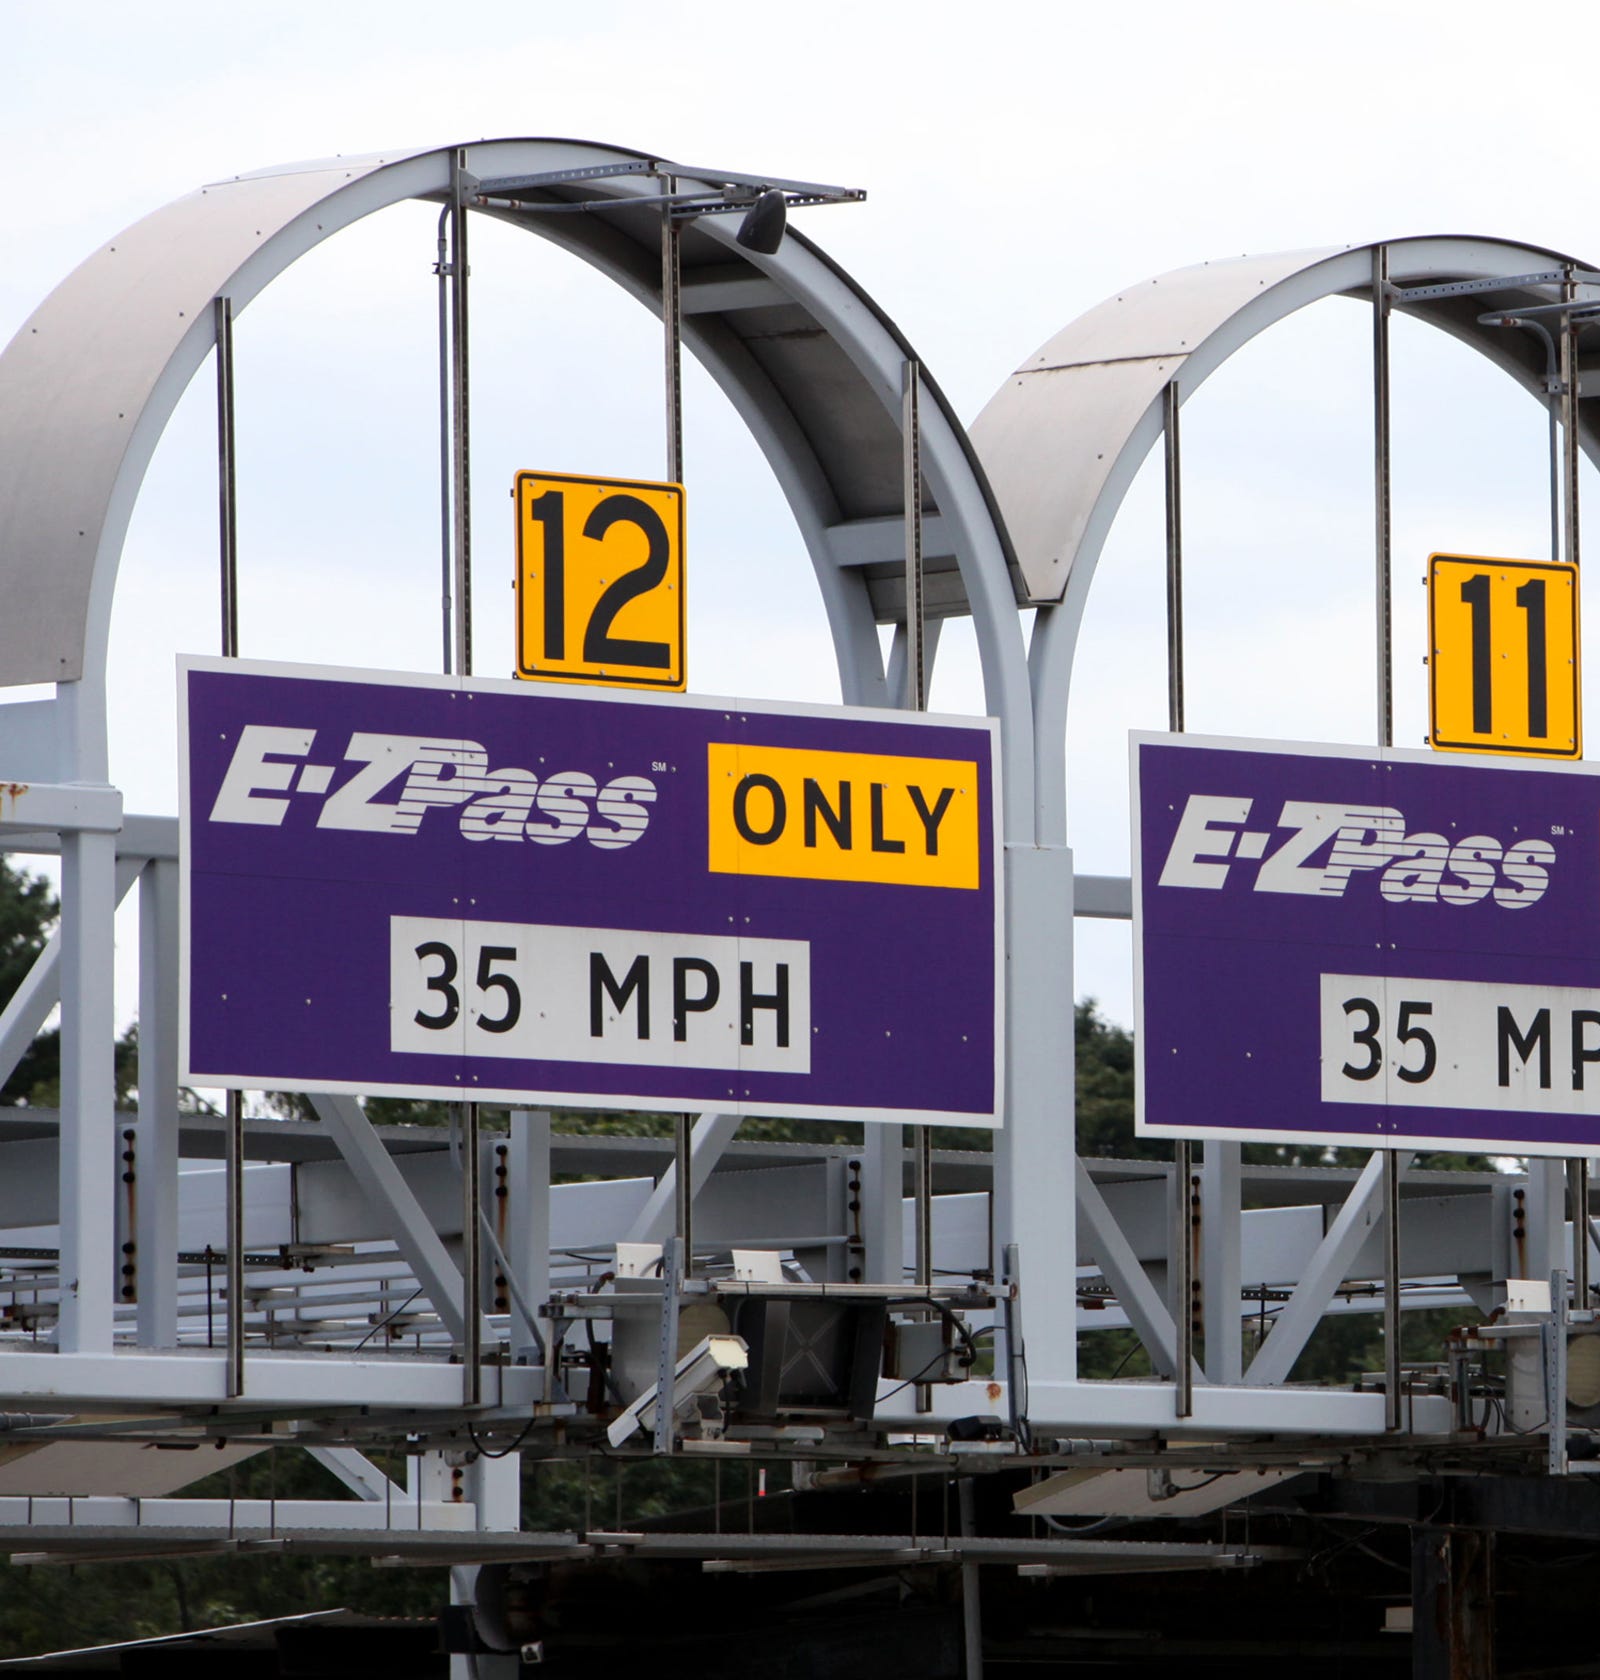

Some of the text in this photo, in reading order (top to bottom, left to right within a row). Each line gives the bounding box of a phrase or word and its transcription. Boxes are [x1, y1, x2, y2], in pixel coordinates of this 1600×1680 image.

[531, 489, 671, 669] 12
[1460, 573, 1549, 739] 11
[209, 725, 657, 849] E-ZPass
[733, 773, 955, 856] ONLY
[1158, 794, 1556, 909] E-ZPass
[414, 942, 790, 1048] 35 MPH
[1341, 997, 1437, 1084] 35
